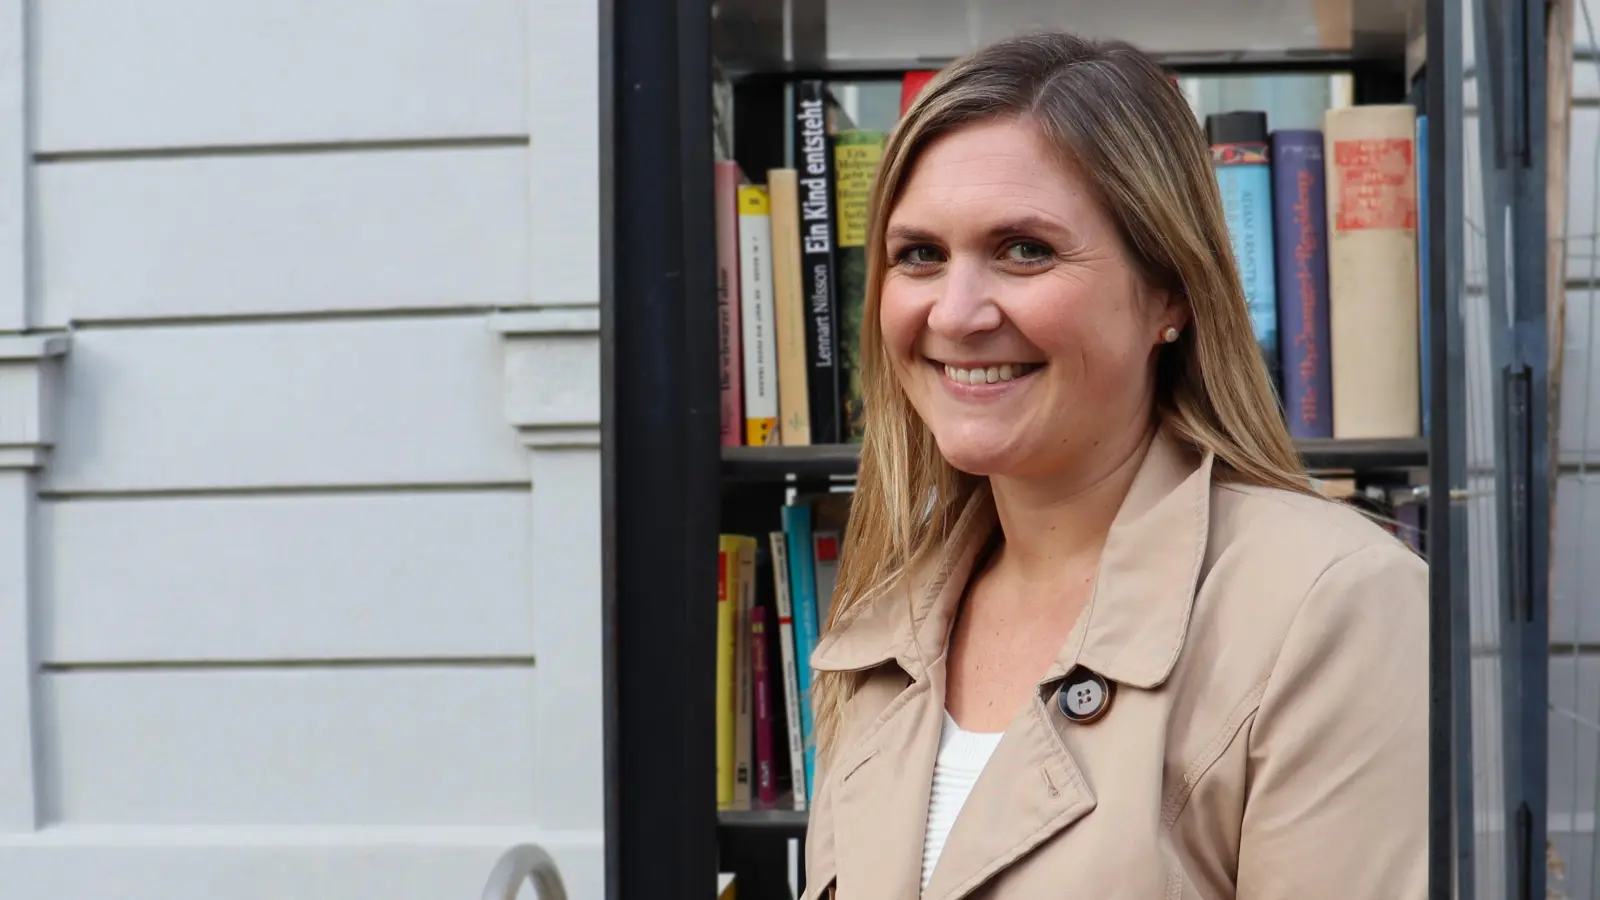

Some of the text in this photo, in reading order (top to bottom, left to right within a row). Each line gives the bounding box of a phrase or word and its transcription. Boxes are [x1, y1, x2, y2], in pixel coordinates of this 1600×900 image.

[796, 99, 830, 254] Ein Kind entsteht
[812, 263, 832, 367] Lennart Nilsson
